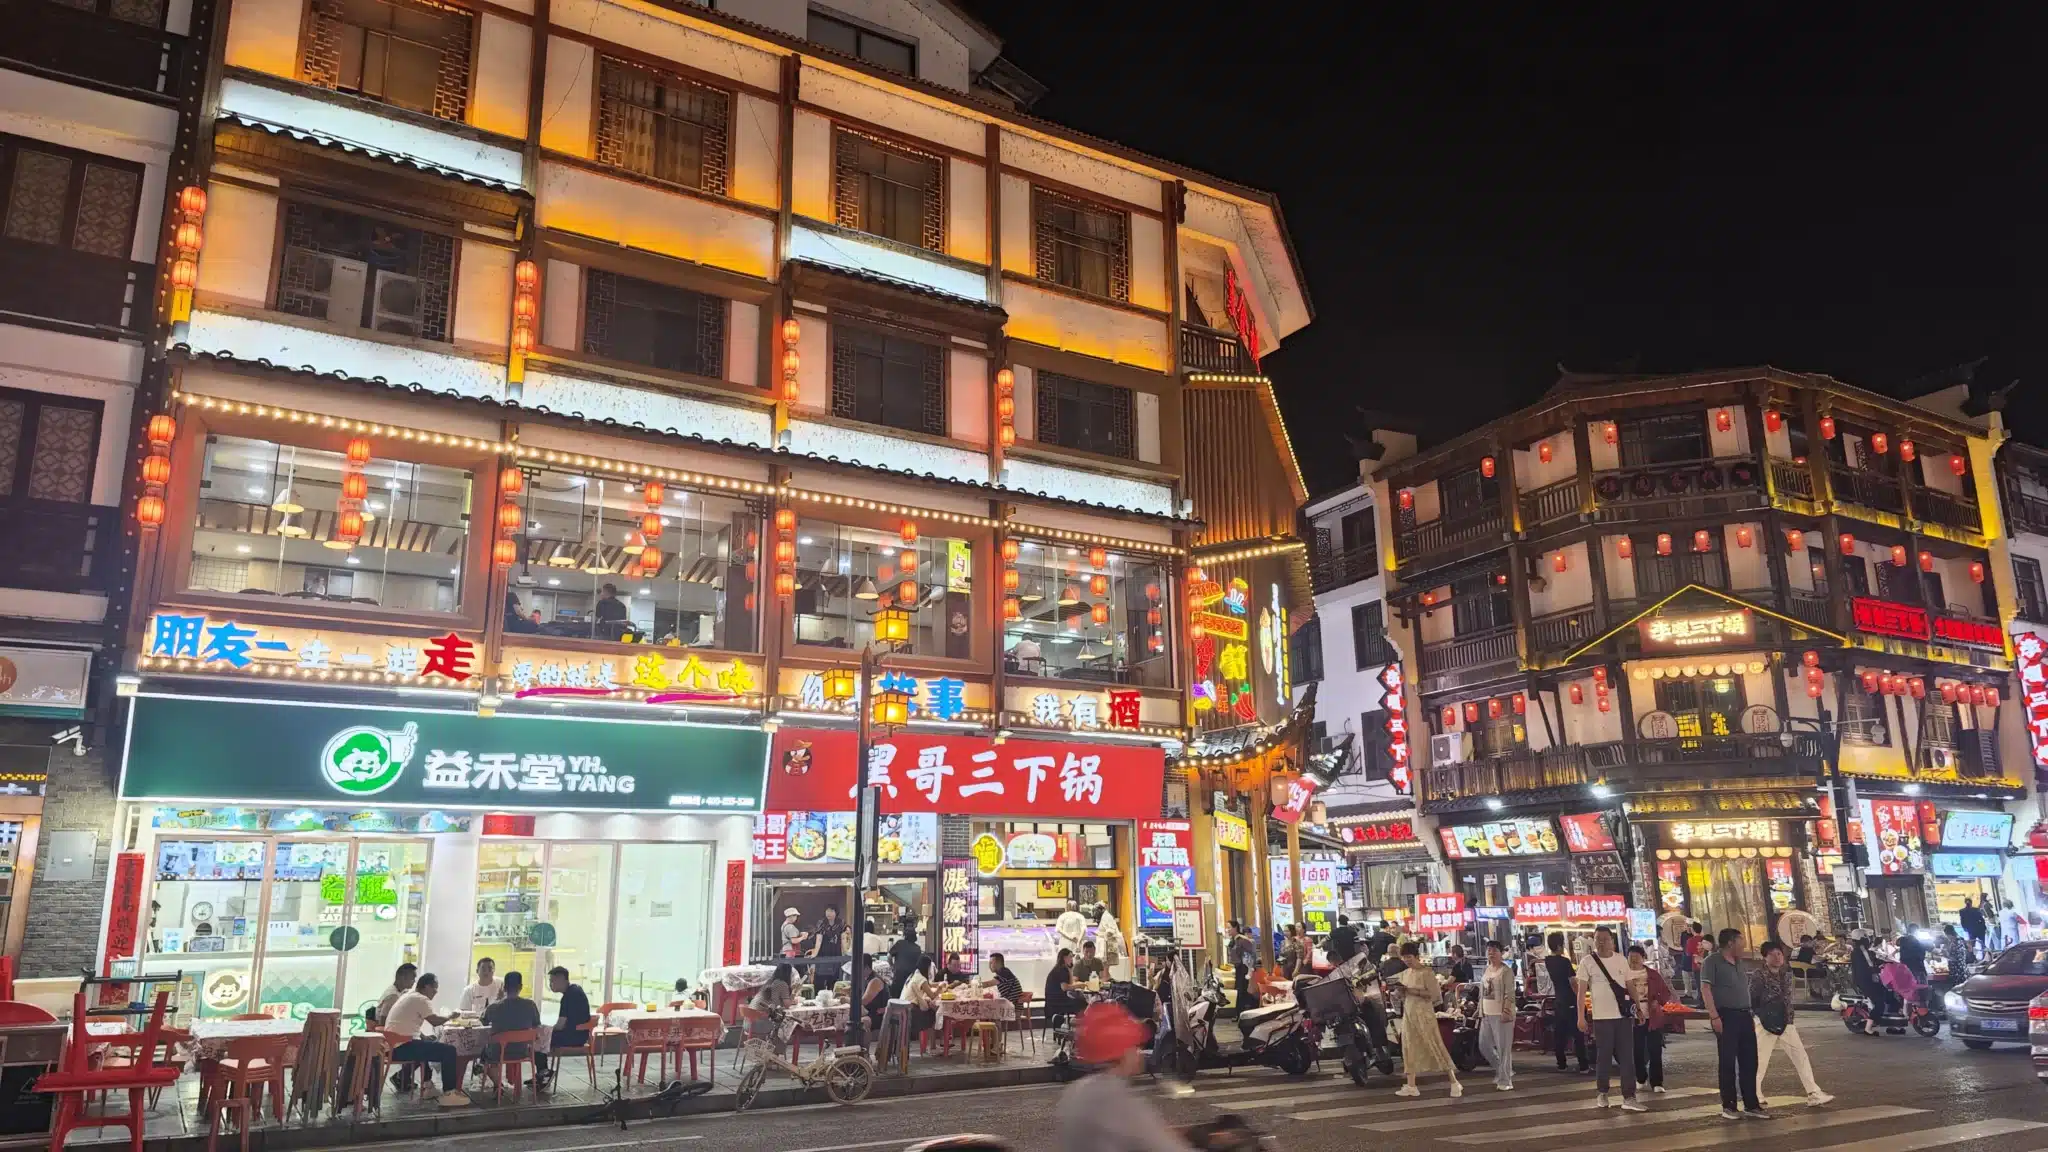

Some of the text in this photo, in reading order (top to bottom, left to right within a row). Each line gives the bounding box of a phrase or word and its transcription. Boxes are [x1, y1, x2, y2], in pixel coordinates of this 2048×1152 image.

[152, 614, 475, 682] 朋友一生一起走
[1032, 688, 1141, 729] 我有酒
[422, 749, 566, 792] 益禾堂
[563, 773, 636, 794] TANG
[849, 743, 1104, 804] 黑哥三下锅
